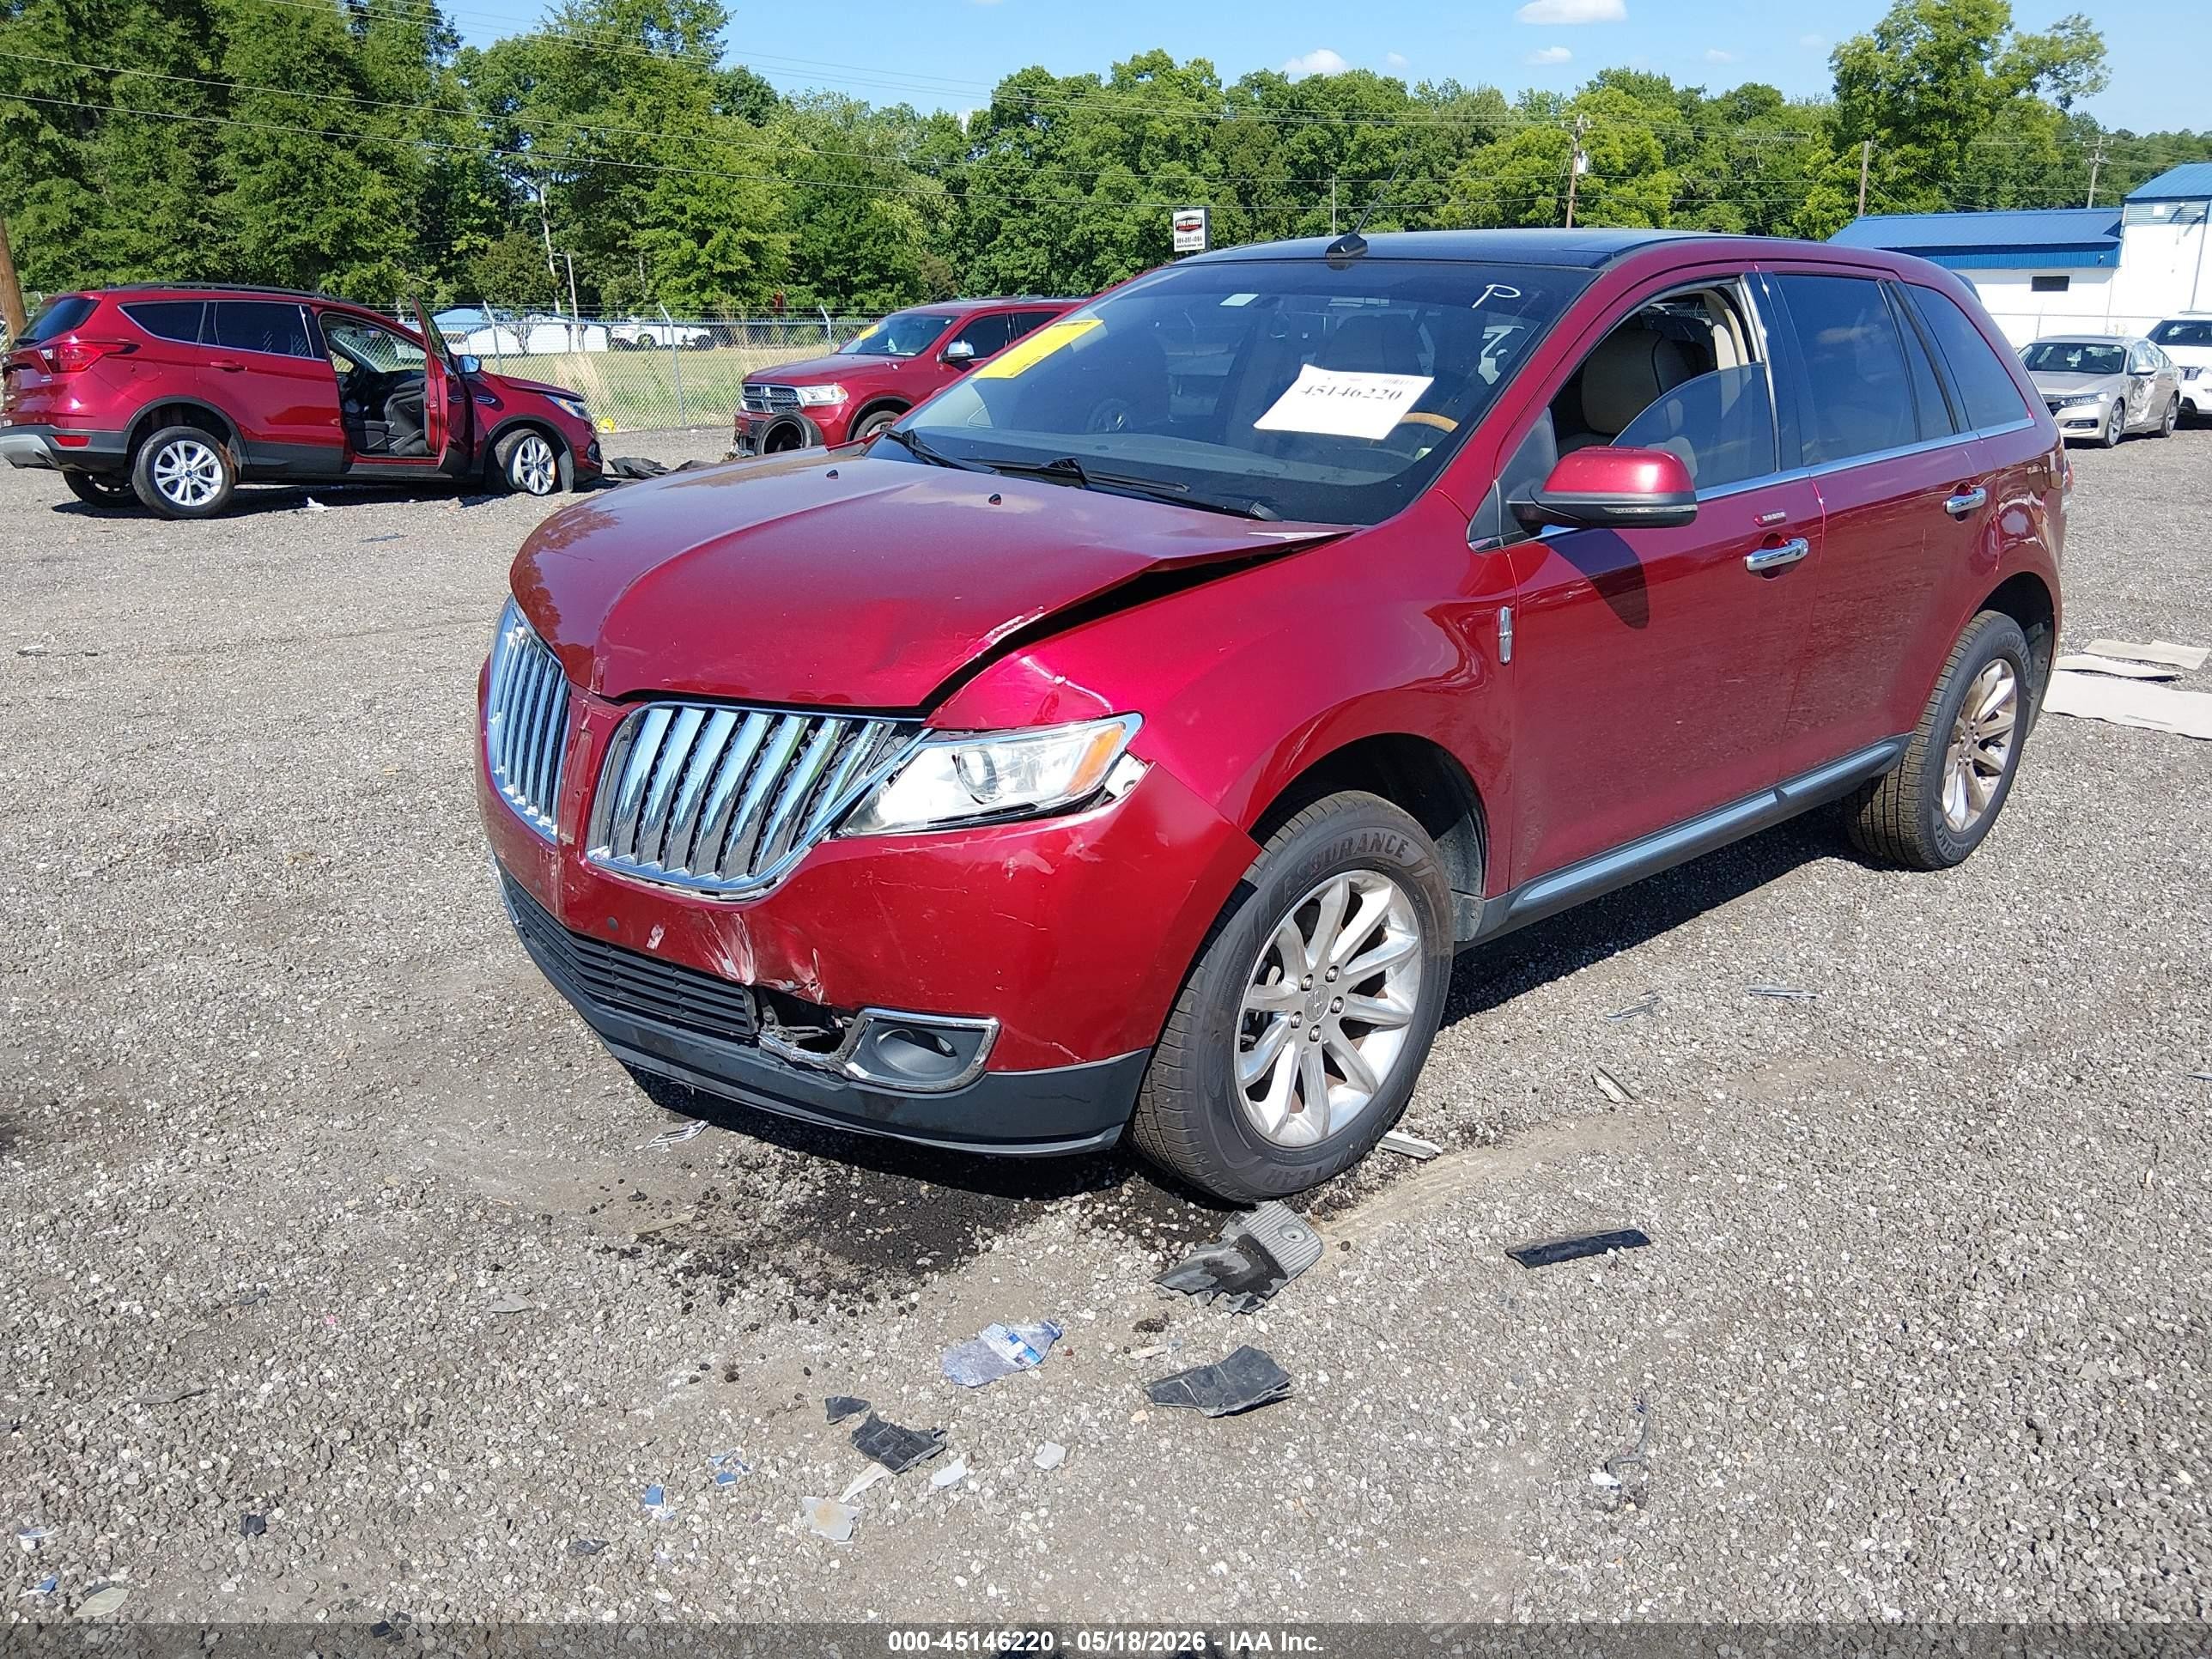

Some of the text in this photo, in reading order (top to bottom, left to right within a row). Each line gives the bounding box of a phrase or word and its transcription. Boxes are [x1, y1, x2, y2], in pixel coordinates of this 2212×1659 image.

[1470, 283, 1521, 309] P
[1300, 385, 1404, 401] 45146220
[1284, 831, 1410, 903] ASSURANCE
